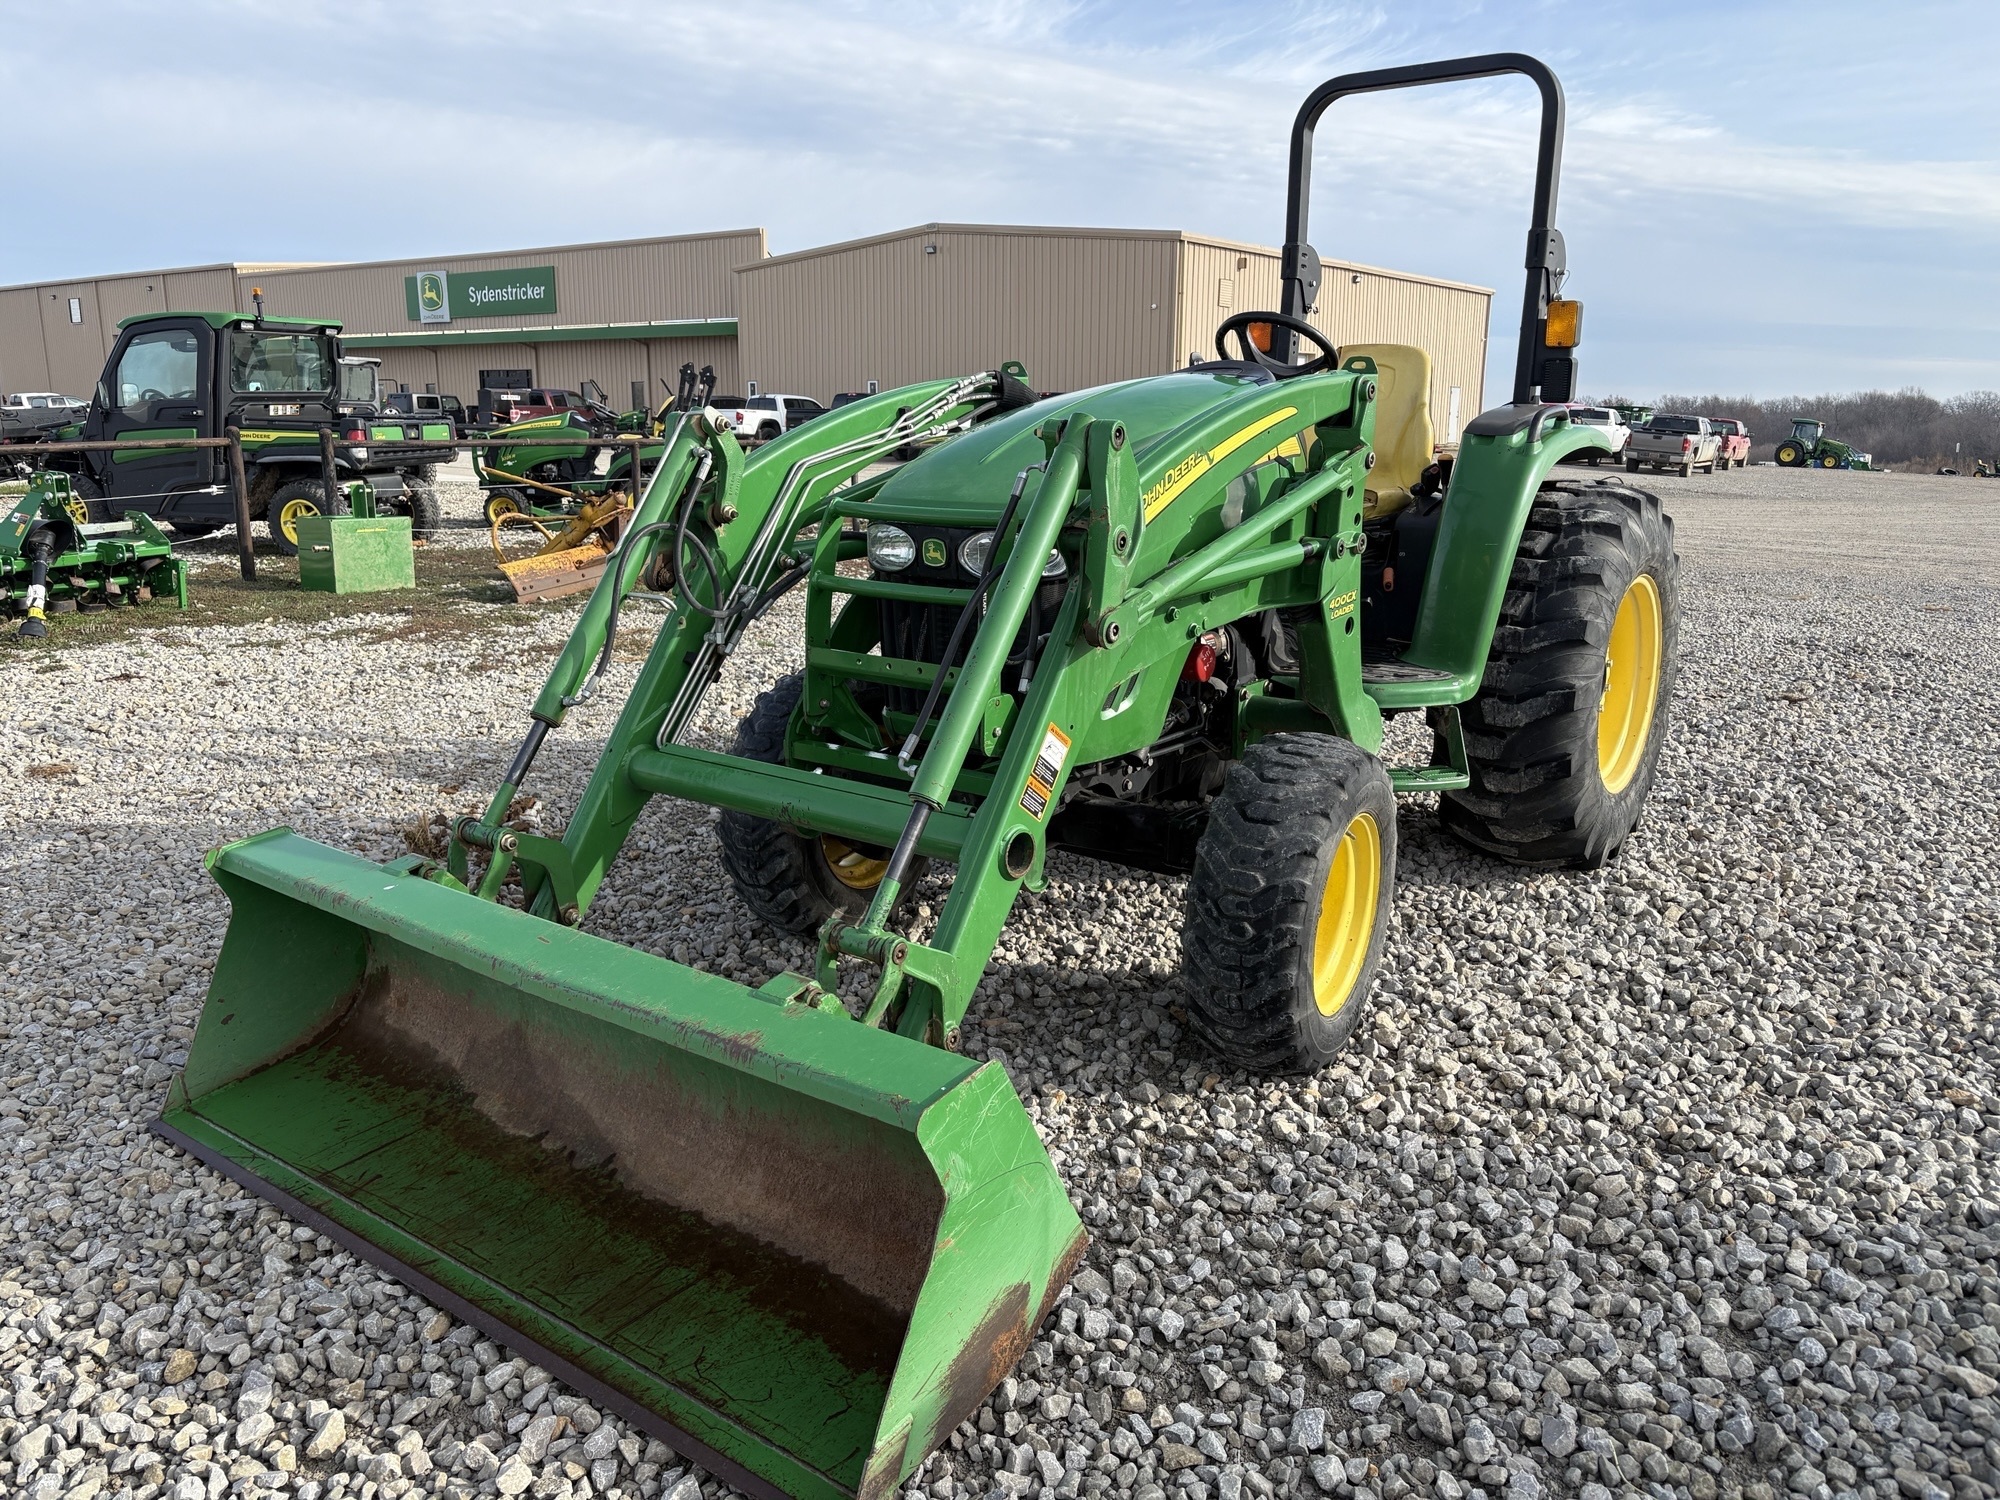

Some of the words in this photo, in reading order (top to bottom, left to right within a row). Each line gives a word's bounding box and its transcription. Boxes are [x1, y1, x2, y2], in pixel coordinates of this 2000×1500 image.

[468, 282, 545, 306] Sydenstricker
[1142, 478, 1165, 510] OHN
[1329, 589, 1358, 610] 400CX
[1331, 604, 1355, 620] LOADER
